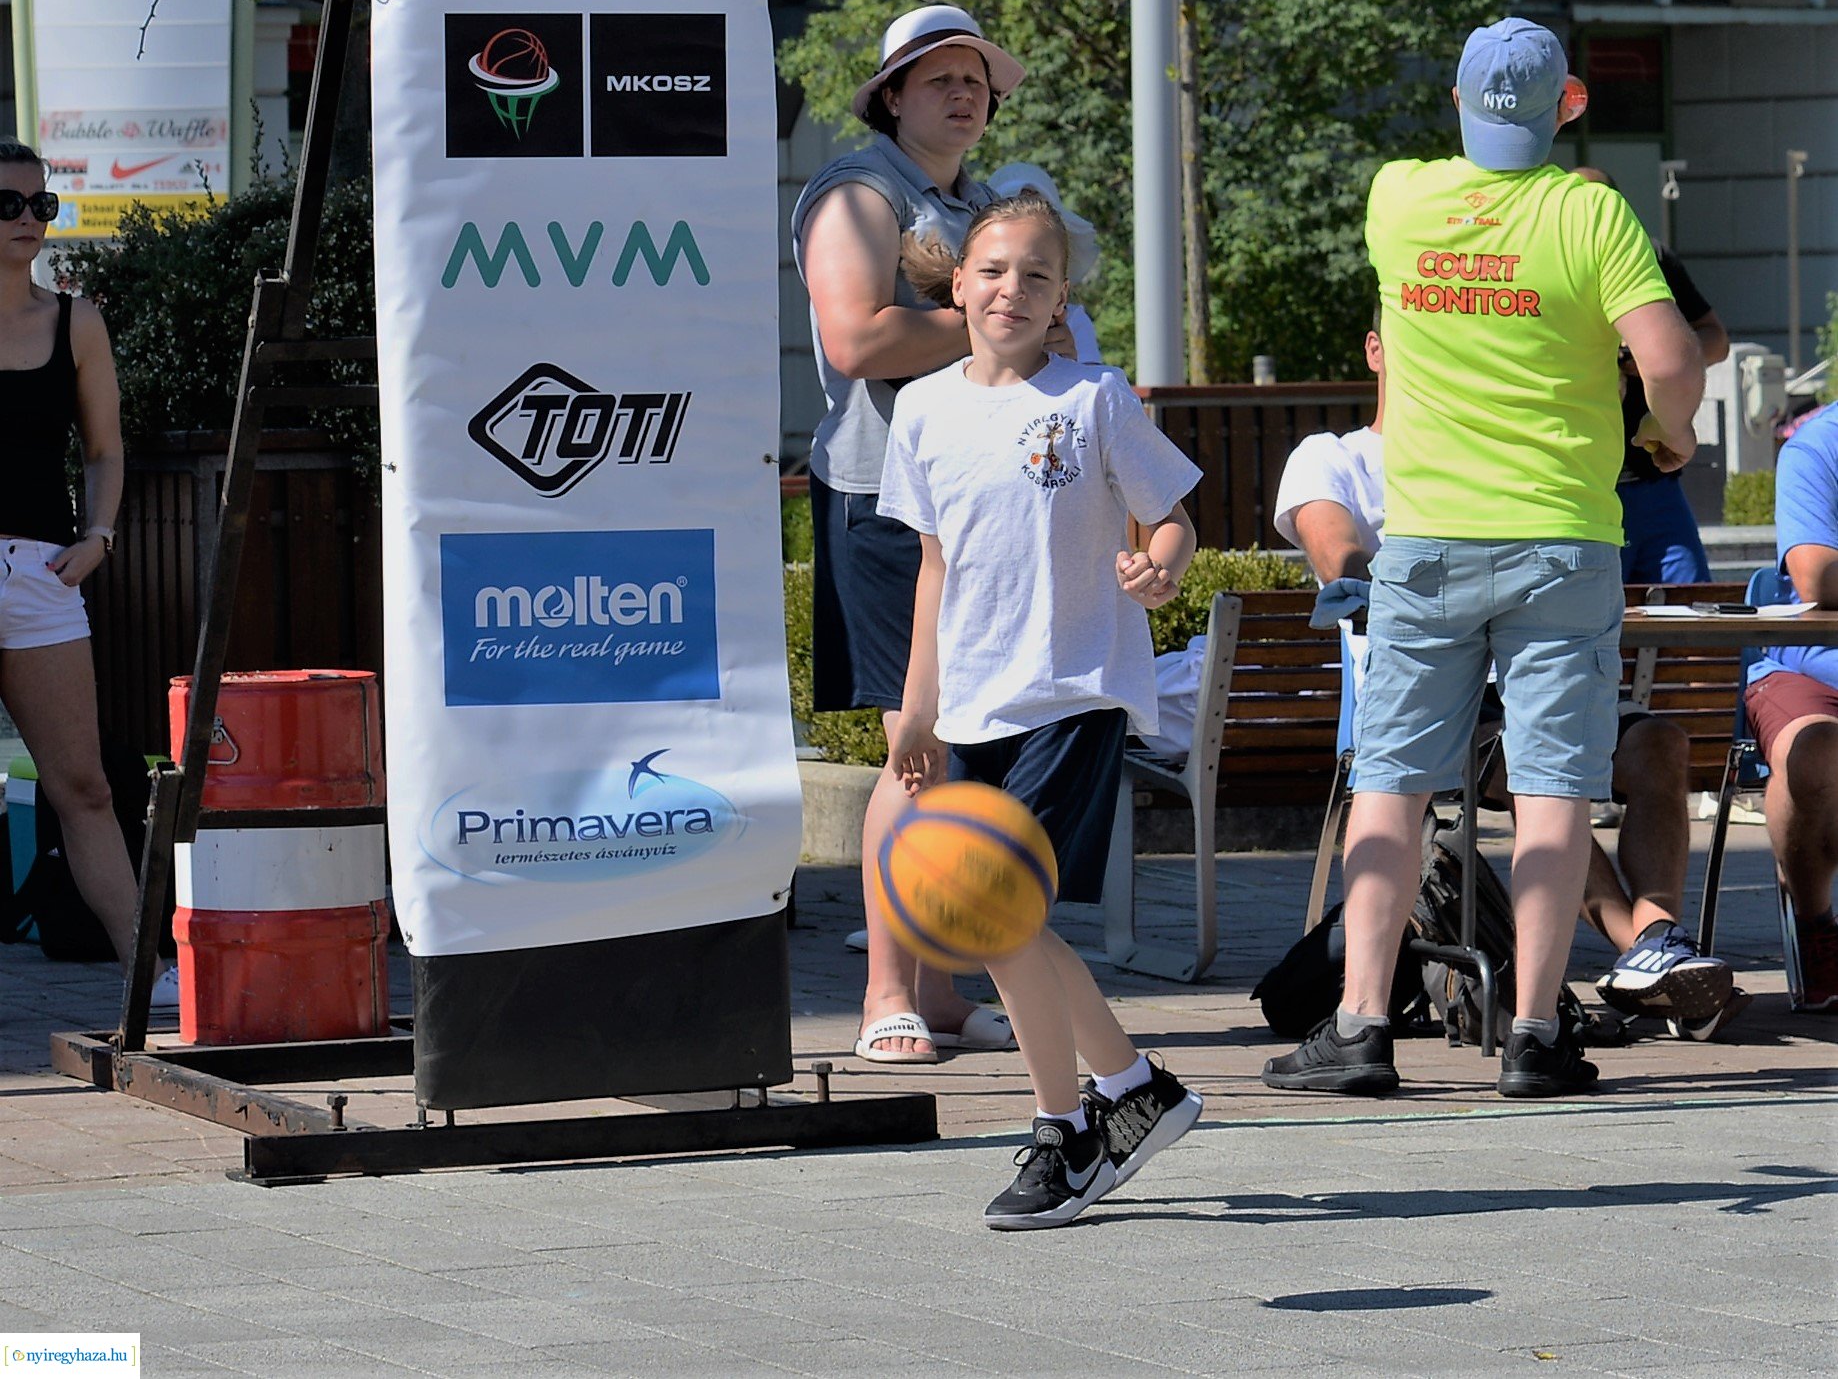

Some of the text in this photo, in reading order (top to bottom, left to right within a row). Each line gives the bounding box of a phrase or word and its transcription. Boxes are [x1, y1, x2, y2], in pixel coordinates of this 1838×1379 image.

[606, 74, 712, 92] MKOSZ
[1483, 92, 1518, 110] NYC
[441, 220, 711, 289] MVM
[1417, 250, 1521, 282] COURT
[1400, 282, 1541, 317] MONITOR
[518, 391, 692, 465] TOTI
[475, 575, 684, 628] molten
[469, 633, 688, 666] For the real game
[458, 807, 715, 846] Primavera
[494, 842, 679, 865] természetes ásványvíz
